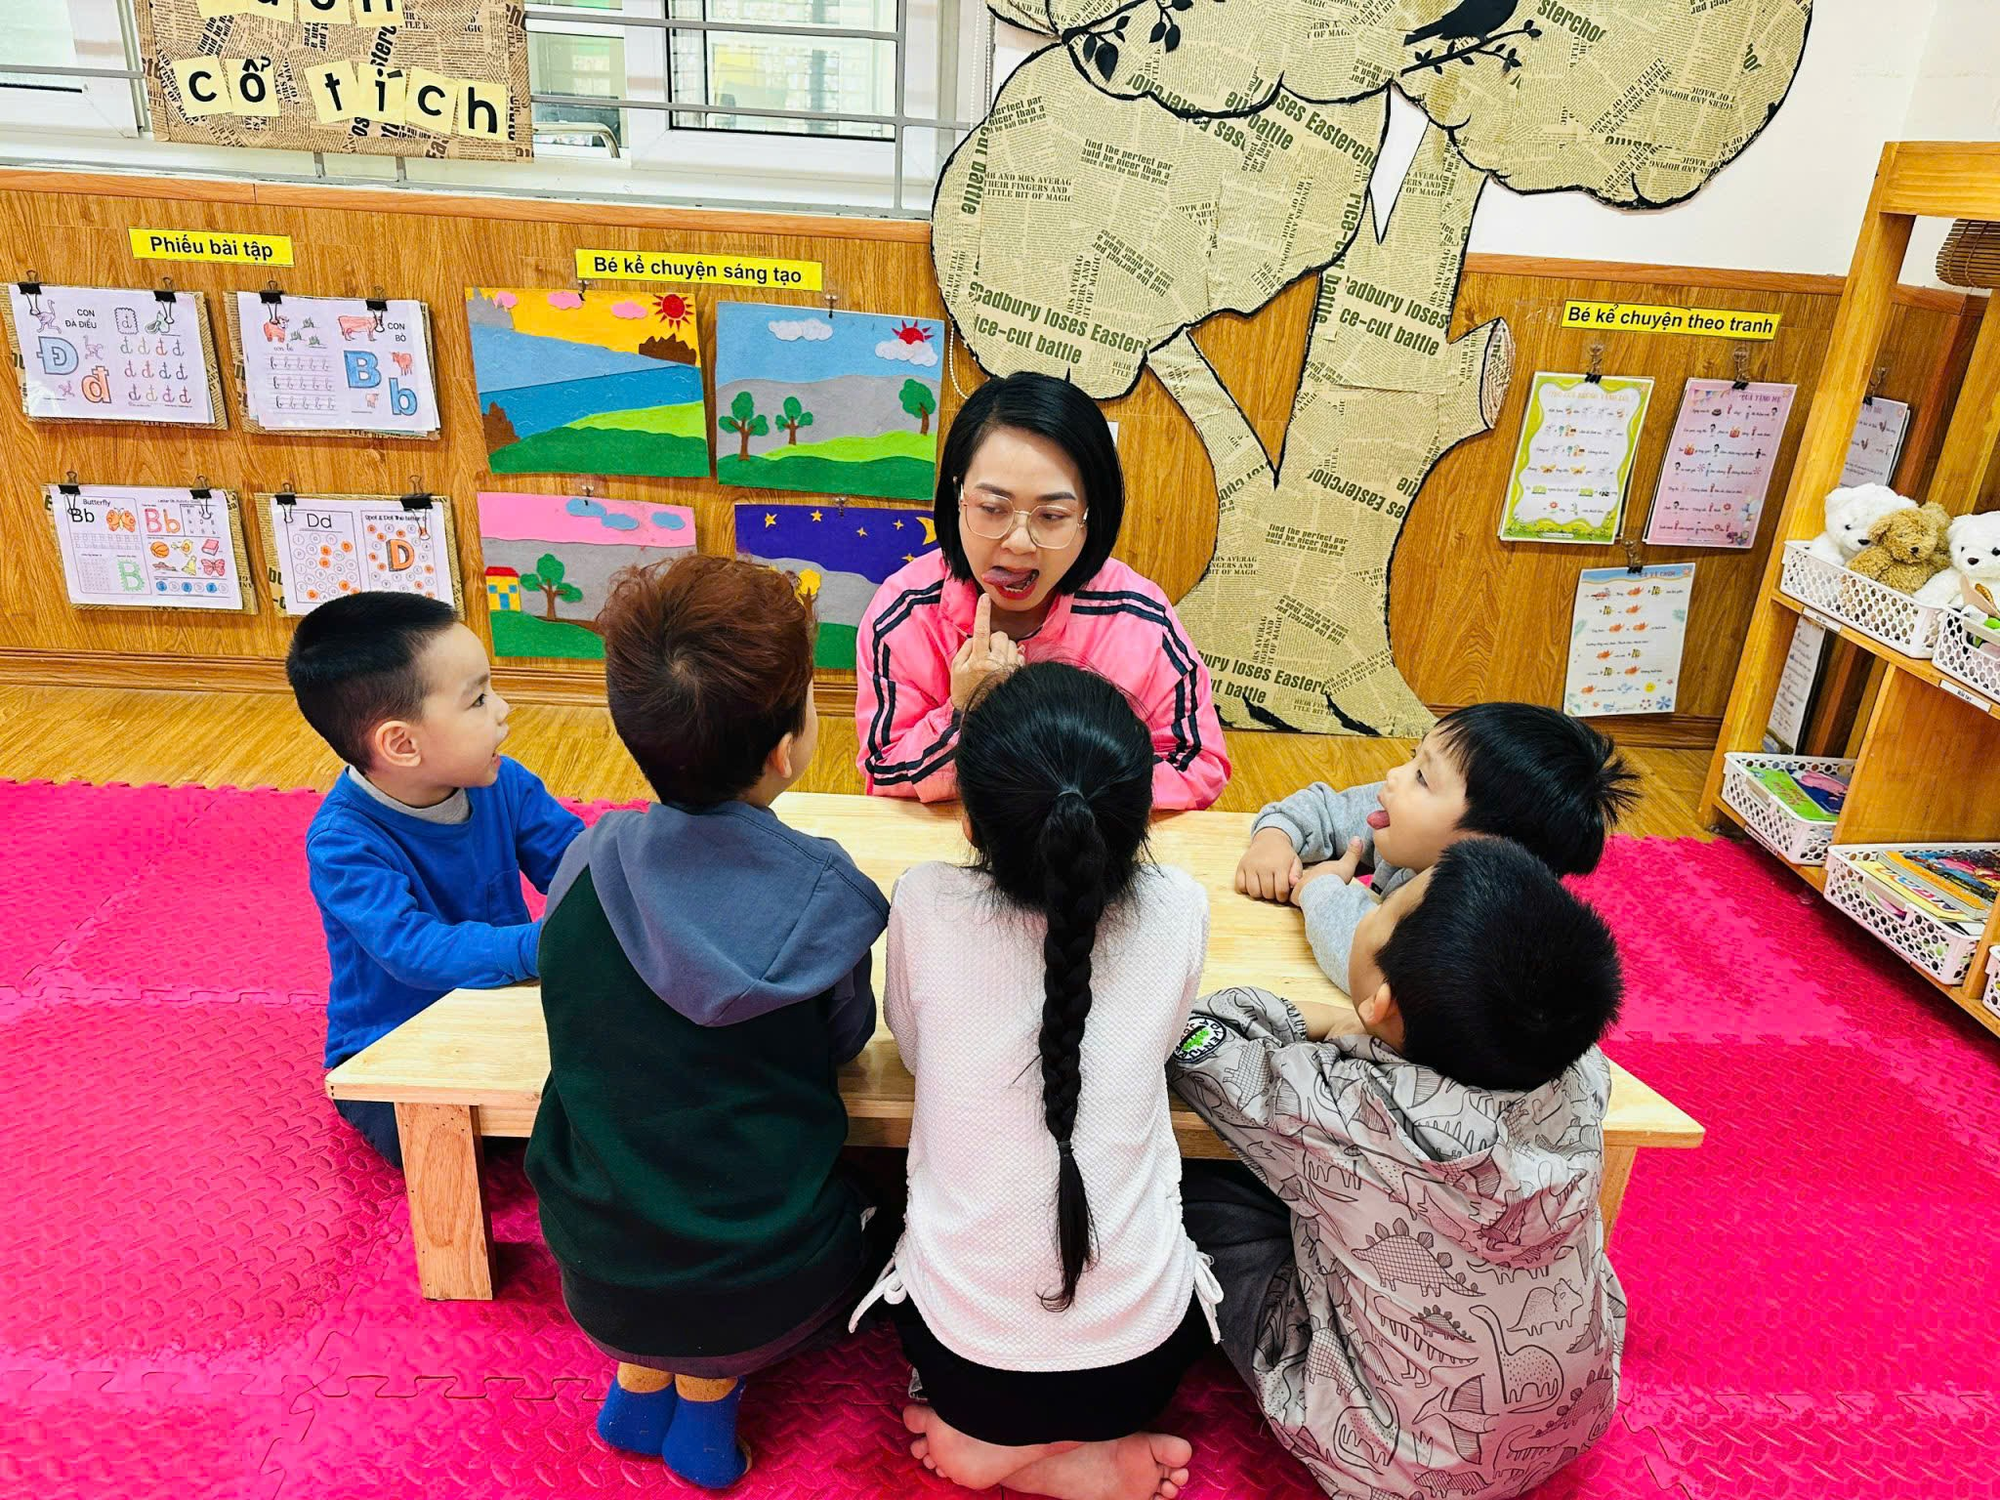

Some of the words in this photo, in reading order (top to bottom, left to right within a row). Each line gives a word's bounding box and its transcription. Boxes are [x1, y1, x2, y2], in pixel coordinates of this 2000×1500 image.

[188, 57, 271, 103] cổ
[325, 70, 498, 134] tích
[1026, 95, 1043, 108] par
[1016, 106, 1037, 119] than
[1084, 138, 1103, 151] find
[1105, 144, 1120, 156] the
[1121, 150, 1156, 166] perfect
[1157, 161, 1174, 171] par
[1103, 153, 1114, 163] be
[1116, 158, 1141, 171] nicer
[1142, 164, 1162, 177] than
[1164, 171, 1171, 180] a
[999, 172, 1016, 181] AND
[1037, 176, 1072, 186] AVERAG
[1011, 182, 1049, 192] FINGERS
[1050, 185, 1068, 194] AND
[1151, 176, 1169, 187] price
[1015, 191, 1030, 199] BIT
[1031, 192, 1044, 200] OF
[150, 235, 204, 254] Phiếu
[209, 239, 238, 256] bài
[244, 240, 274, 261] tập
[594, 256, 618, 273] Bé
[624, 254, 645, 274] kể
[651, 257, 717, 280] chuyện
[723, 263, 767, 284] sáng
[774, 266, 802, 287] tạo
[76, 308, 96, 318] CON
[1345, 277, 1404, 314] adbury
[1405, 299, 1448, 329] loses
[387, 321, 406, 331] CON
[1043, 307, 1089, 337] loses
[1567, 306, 1590, 323] Bé
[1595, 303, 1619, 323] kể
[1620, 308, 1682, 331] chuyện
[1687, 311, 1724, 331] theo
[1729, 314, 1774, 334] tranh
[1036, 334, 1083, 365] battle
[1393, 325, 1440, 356] battle
[36, 335, 79, 376] Đ
[343, 350, 382, 389] B
[81, 365, 112, 404] đ
[388, 377, 418, 416] b
[70, 508, 95, 523] Bb
[82, 498, 111, 507] Butterfly
[306, 512, 333, 529] Dd
[1287, 527, 1300, 536] the
[1301, 530, 1333, 542] perfect
[1333, 537, 1349, 545] par
[386, 538, 415, 572] D
[1232, 659, 1272, 681] loses
[1224, 681, 1267, 704] battle
